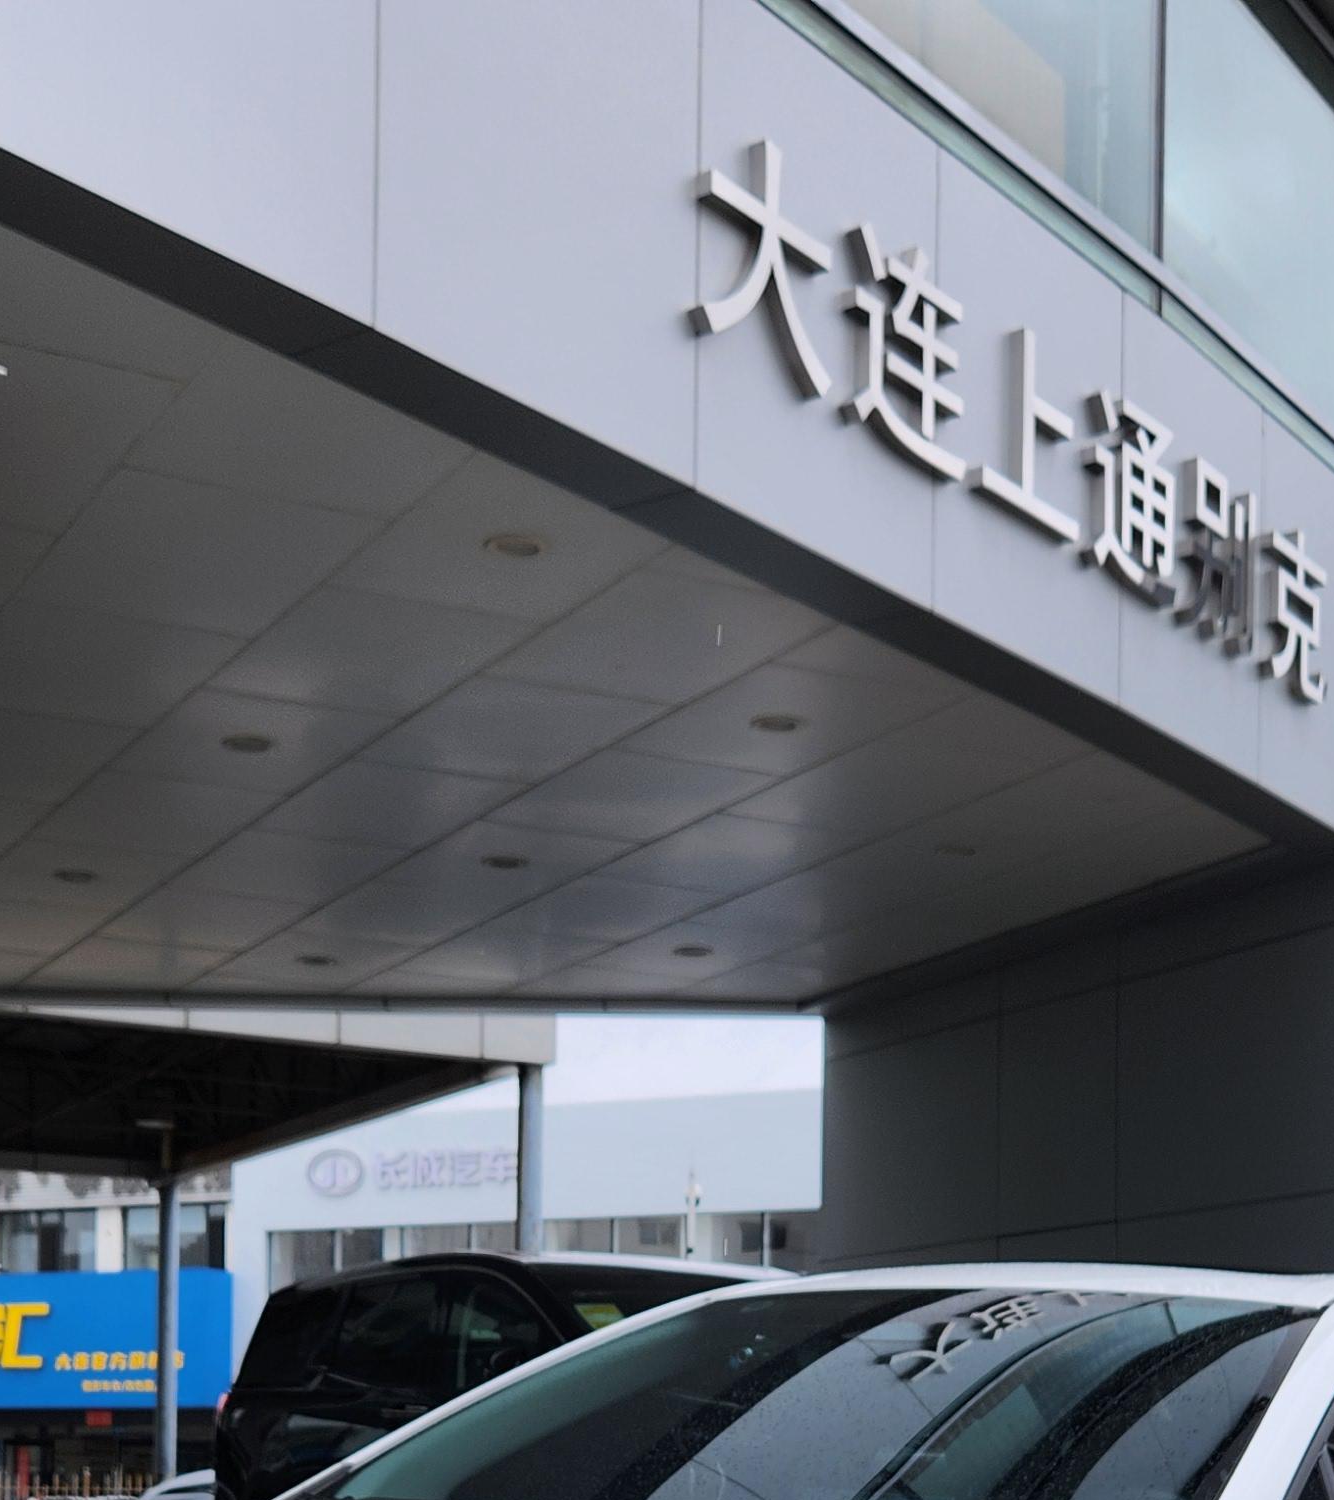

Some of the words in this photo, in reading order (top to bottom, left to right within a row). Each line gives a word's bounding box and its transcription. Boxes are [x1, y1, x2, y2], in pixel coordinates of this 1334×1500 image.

[685, 138, 1329, 704] 大连上通别克
